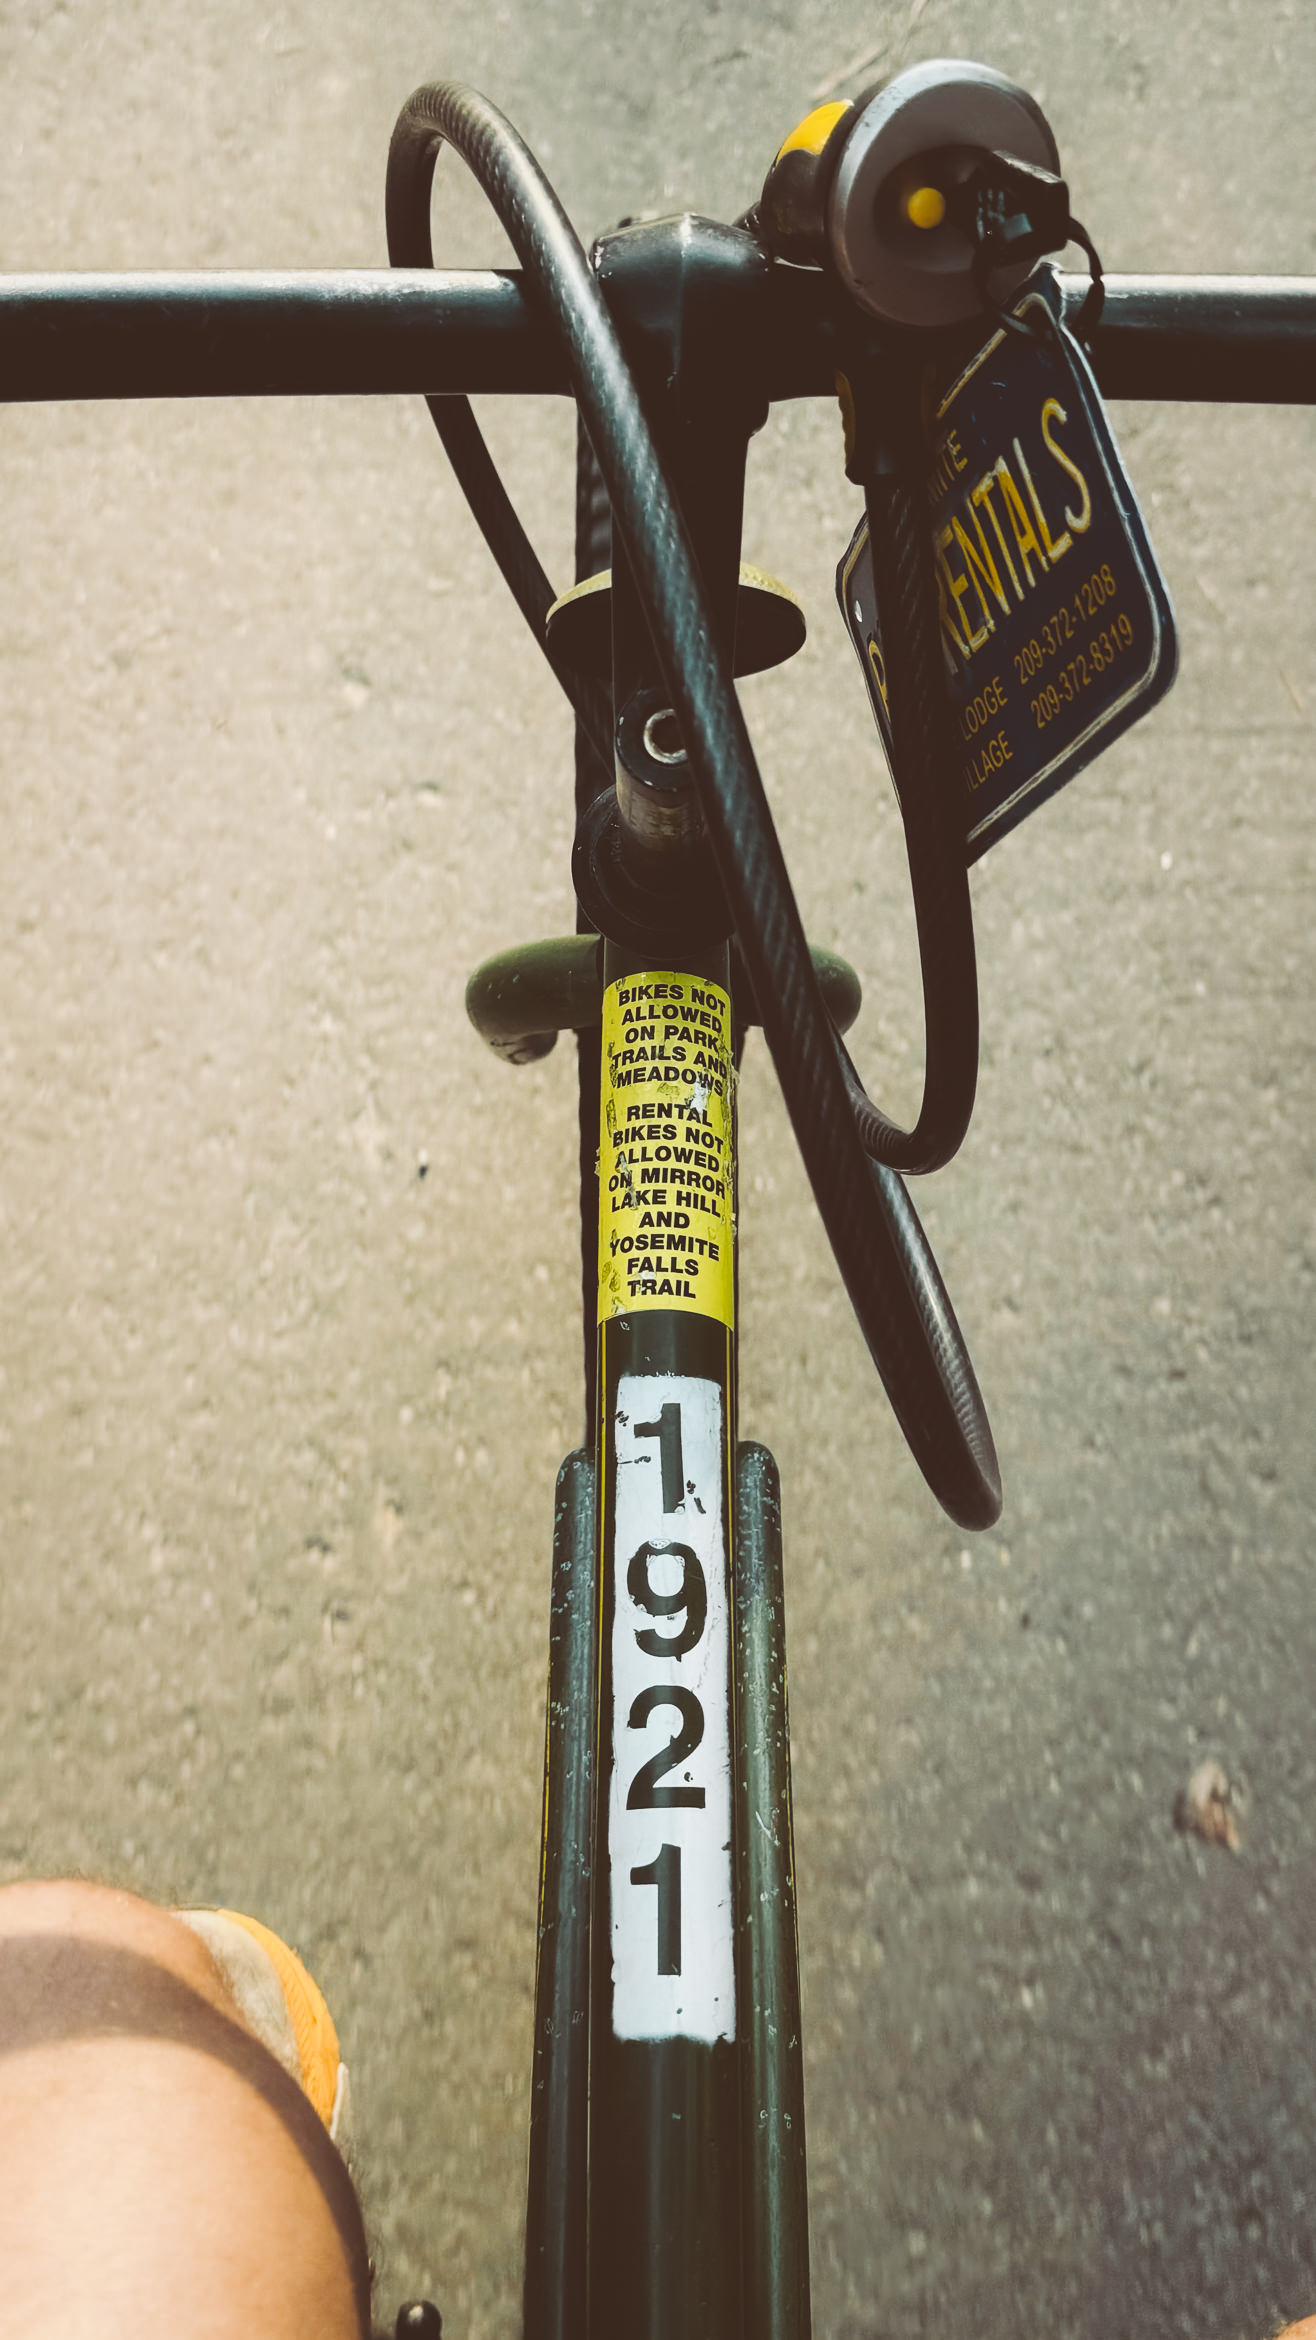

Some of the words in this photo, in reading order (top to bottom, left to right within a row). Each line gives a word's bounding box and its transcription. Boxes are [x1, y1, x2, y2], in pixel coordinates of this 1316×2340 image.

[1014, 564, 1116, 684] 209-372-1208
[962, 730, 1013, 792] ILLAGE
[1031, 613, 1133, 728] 209-372-8319
[618, 984, 684, 1007] BIKES
[691, 986, 726, 1016] NOT
[621, 1004, 723, 1034] ALLOWED
[625, 1025, 656, 1044] ON
[664, 1025, 719, 1054] PARK
[612, 1045, 687, 1070] TRAILS
[693, 1051, 728, 1080] AND
[615, 1066, 723, 1097] MEADOWS
[627, 1103, 713, 1128] RENTAL
[613, 1124, 677, 1148] BIKES
[685, 1126, 724, 1154] NOT
[615, 1145, 720, 1172] ALLOWED
[608, 1170, 633, 1192] ON
[641, 1168, 726, 1200] MIRROR
[612, 1189, 667, 1213] LAKE
[676, 1190, 722, 1218] HILL
[638, 1211, 690, 1228] AND
[610, 1234, 720, 1261] YOSEMITE
[627, 1256, 699, 1276] FALLS
[627, 1279, 697, 1299] TRAIL
[626, 1402, 708, 1976] 1921
